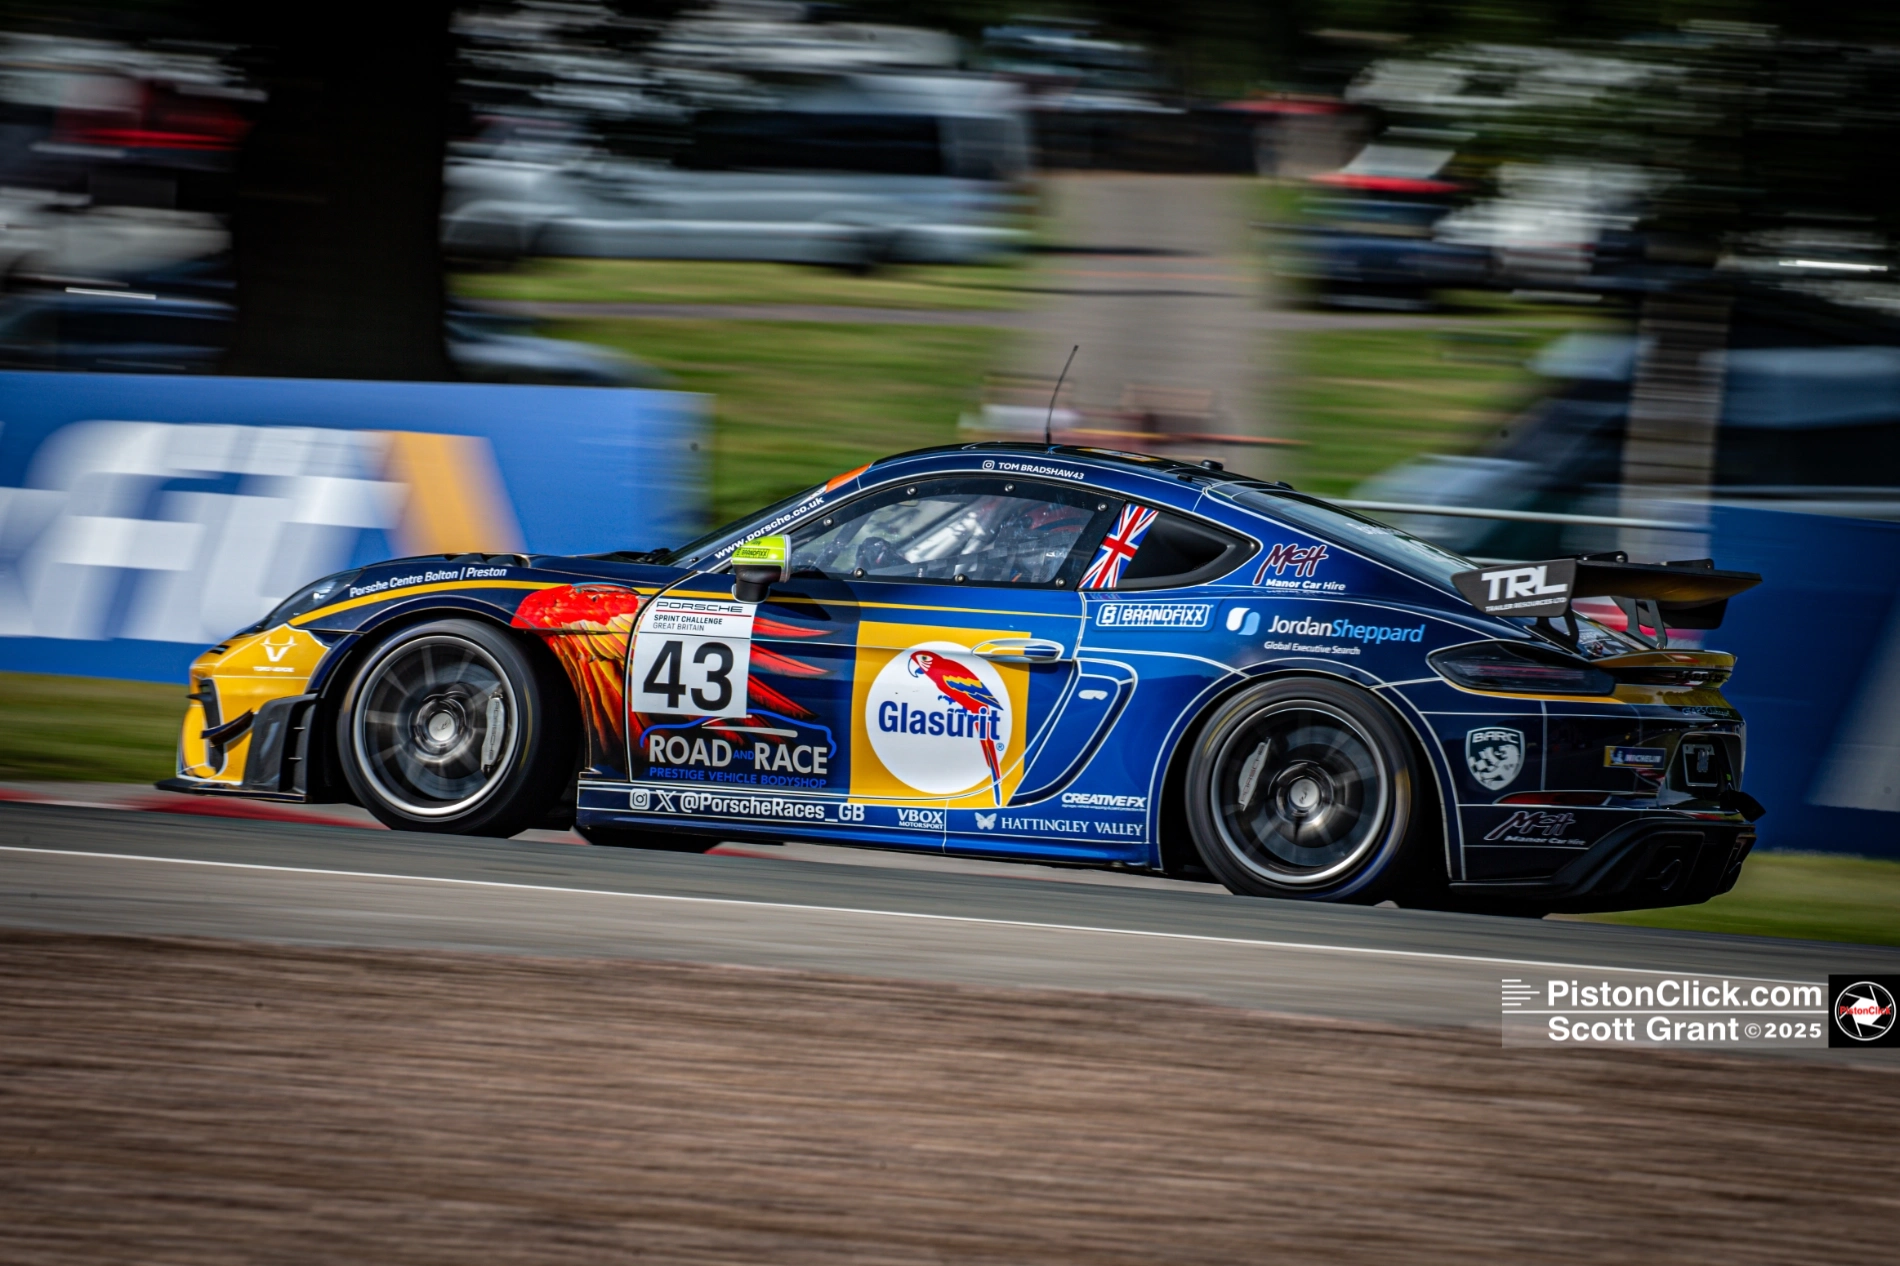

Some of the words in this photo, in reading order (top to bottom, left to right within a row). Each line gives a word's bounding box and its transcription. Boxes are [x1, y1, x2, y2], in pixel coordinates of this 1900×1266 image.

[998, 462, 1019, 471] TOM
[1020, 464, 1085, 480] BRADSHAW43
[714, 496, 825, 559] www.porsche.co.uk
[1252, 543, 1329, 586] MCH
[350, 581, 388, 598] Porsche
[389, 575, 423, 588] Centre
[424, 570, 458, 582] Bolton
[465, 567, 507, 578] Preston
[1265, 578, 1301, 588] Manor
[1302, 580, 1322, 590] Car
[1322, 581, 1347, 591] Hire
[1481, 565, 1568, 601] TRL
[656, 600, 744, 613] PORSCHE
[1121, 607, 1205, 622] BRANDFIXX
[652, 622, 675, 630] GREAT
[676, 623, 705, 632] BRITAIN
[653, 614, 680, 622] SPRINT
[681, 615, 723, 625] CHALLENGE
[1267, 615, 1426, 645] JordanSheppard
[1263, 641, 1292, 651] Global
[1292, 643, 1331, 653] Executive
[1331, 645, 1361, 655] Search
[643, 640, 734, 712] 43
[878, 700, 1001, 740] Glasurit
[1472, 730, 1519, 744] BARC
[649, 734, 732, 768] ROAD
[733, 750, 754, 761] AND
[754, 742, 828, 775] RACE
[650, 767, 705, 781] PRESTIGE
[708, 771, 757, 785] VEHICLE
[760, 774, 827, 789] BODYSHOP
[680, 791, 865, 822] @PorscheRaces_GB
[897, 808, 943, 824] VBOX
[898, 820, 945, 830] MOTORSPORT
[1001, 817, 1090, 833] HATTINGLEY
[1093, 821, 1144, 836] VALLEY
